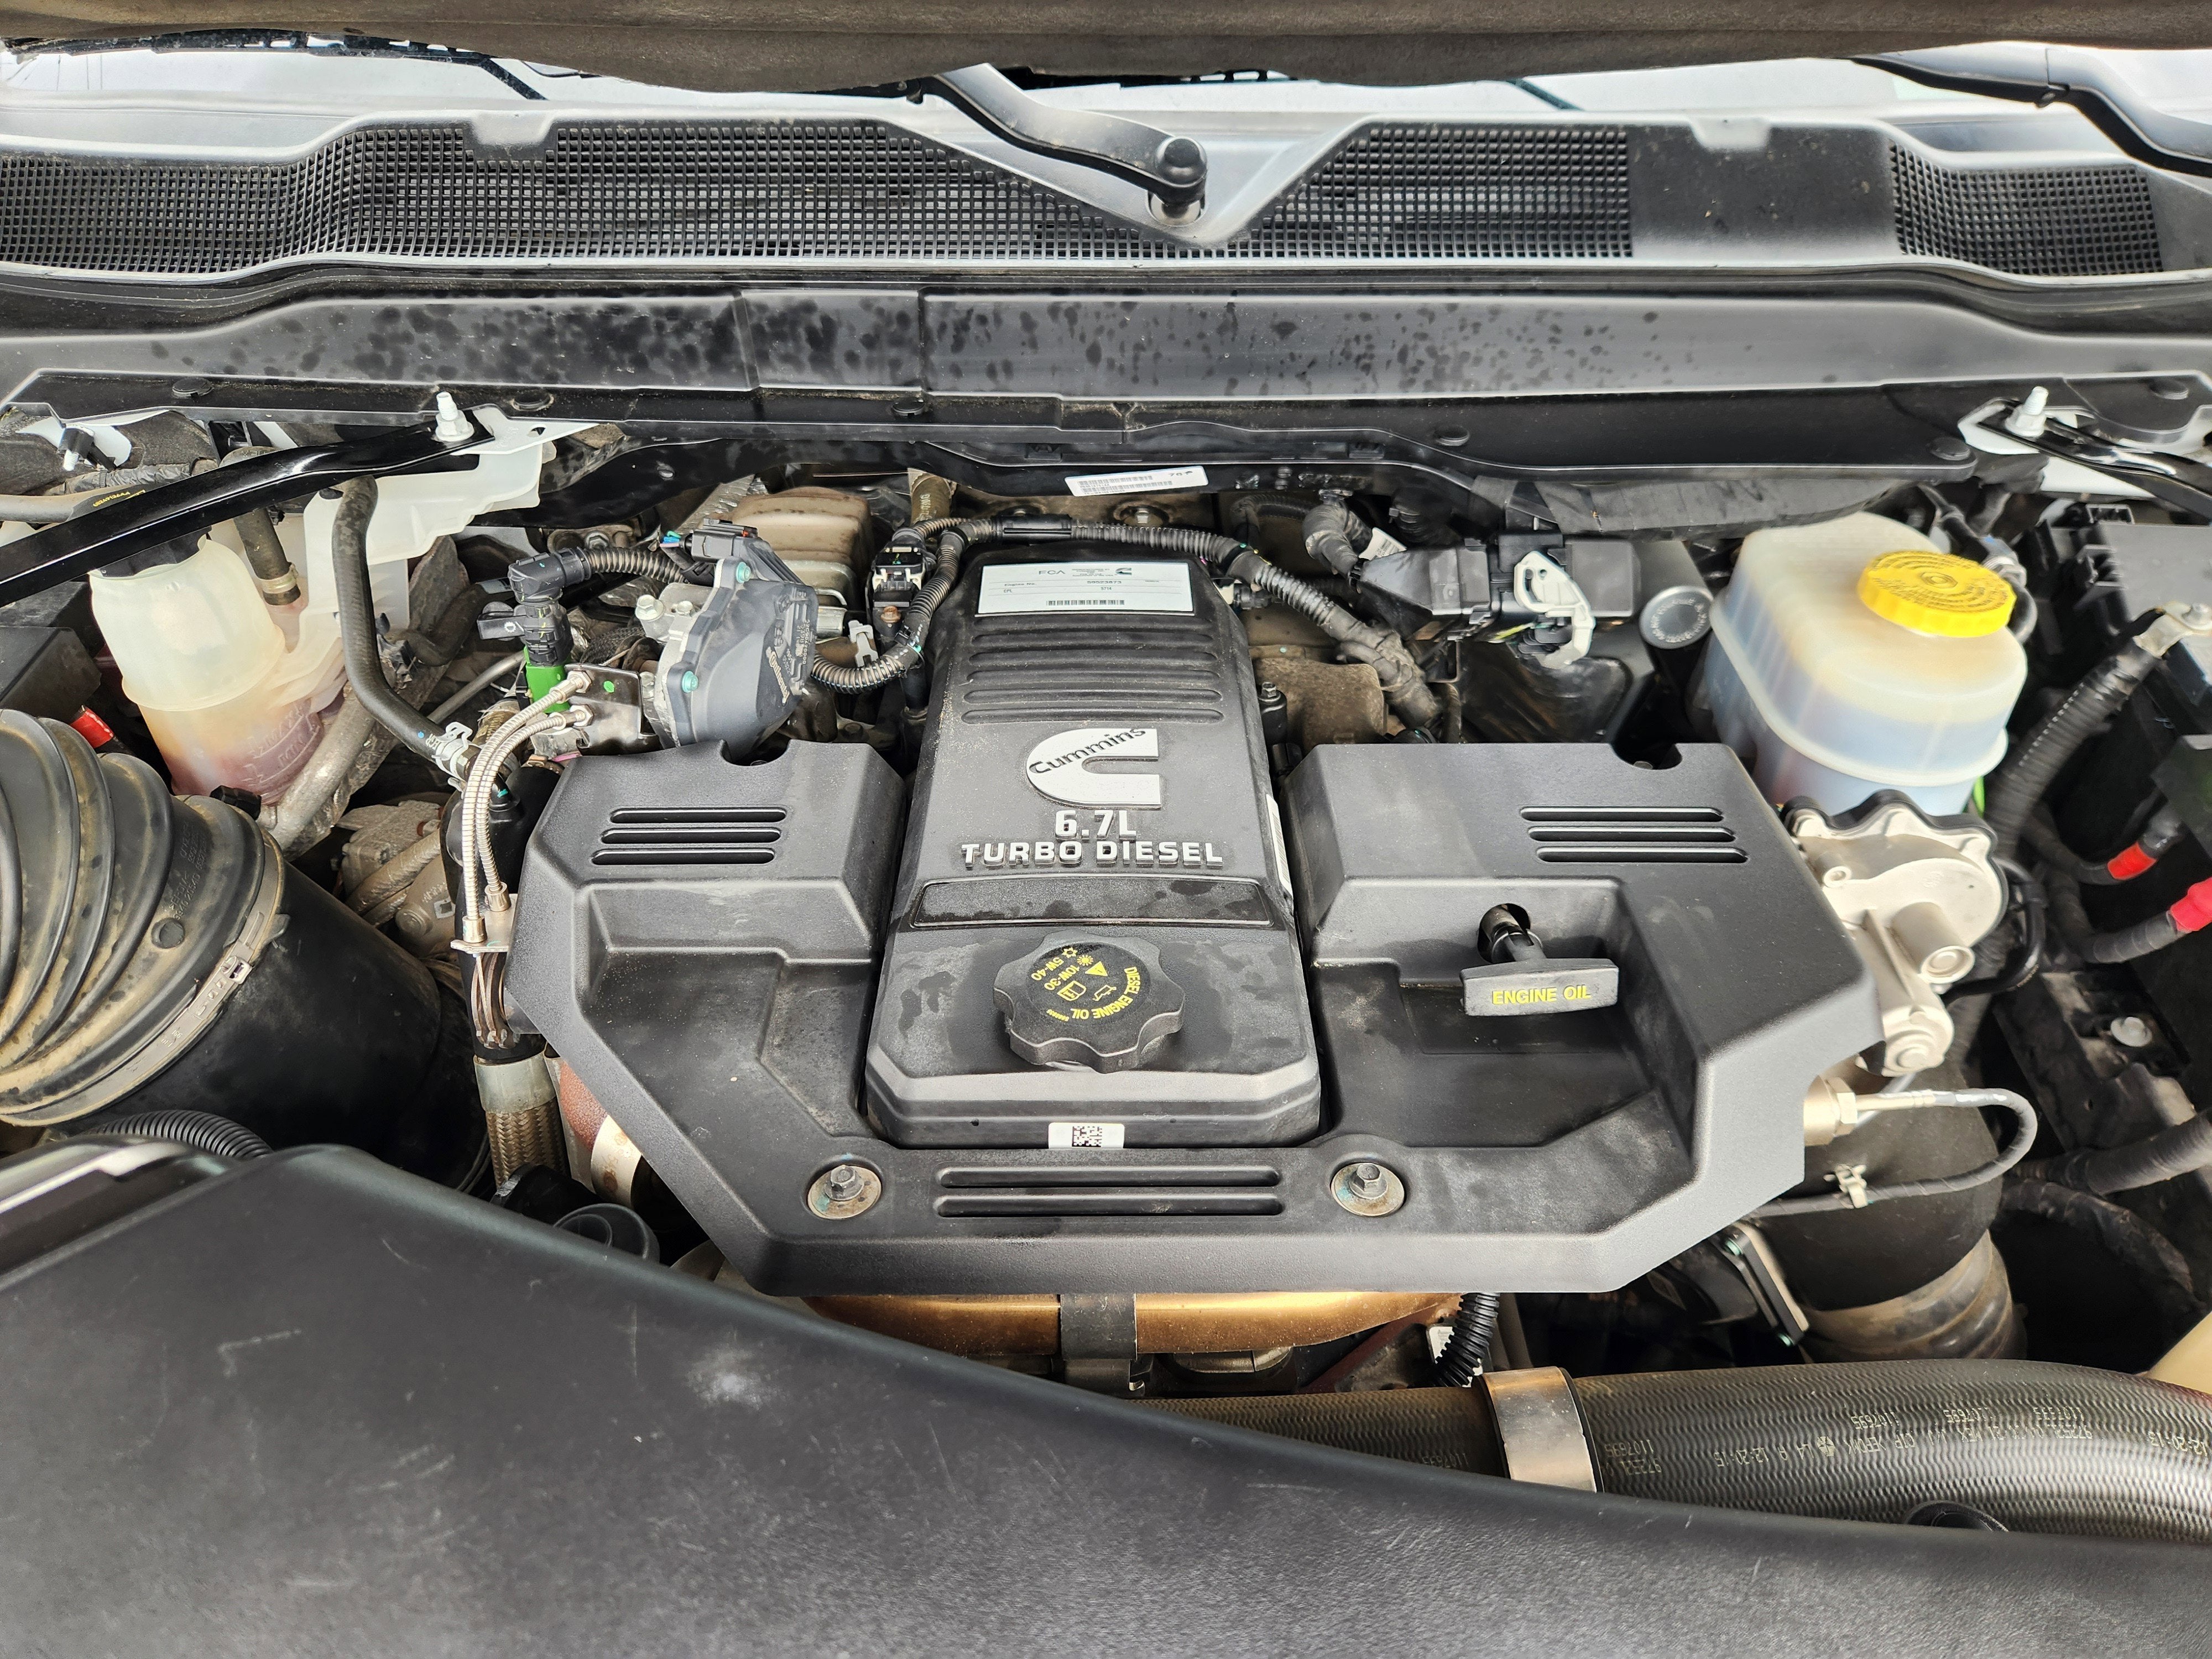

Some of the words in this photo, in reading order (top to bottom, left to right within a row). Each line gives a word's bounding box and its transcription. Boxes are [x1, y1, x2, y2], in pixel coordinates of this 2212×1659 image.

[1028, 727, 1146, 774] Cummins
[1055, 810, 1138, 840] 6.7L
[961, 841, 1083, 867] TURBO
[1095, 841, 1223, 867] DIESEL
[1031, 957, 1065, 981] 5W-40
[1044, 964, 1080, 991] 10W-30
[1124, 966, 1141, 995] DIESEL
[1091, 994, 1134, 1019] ENGINE
[1492, 988, 1558, 1005] ENGINE
[1563, 984, 1591, 1000] OIL
[1070, 1008, 1089, 1020] OIL
